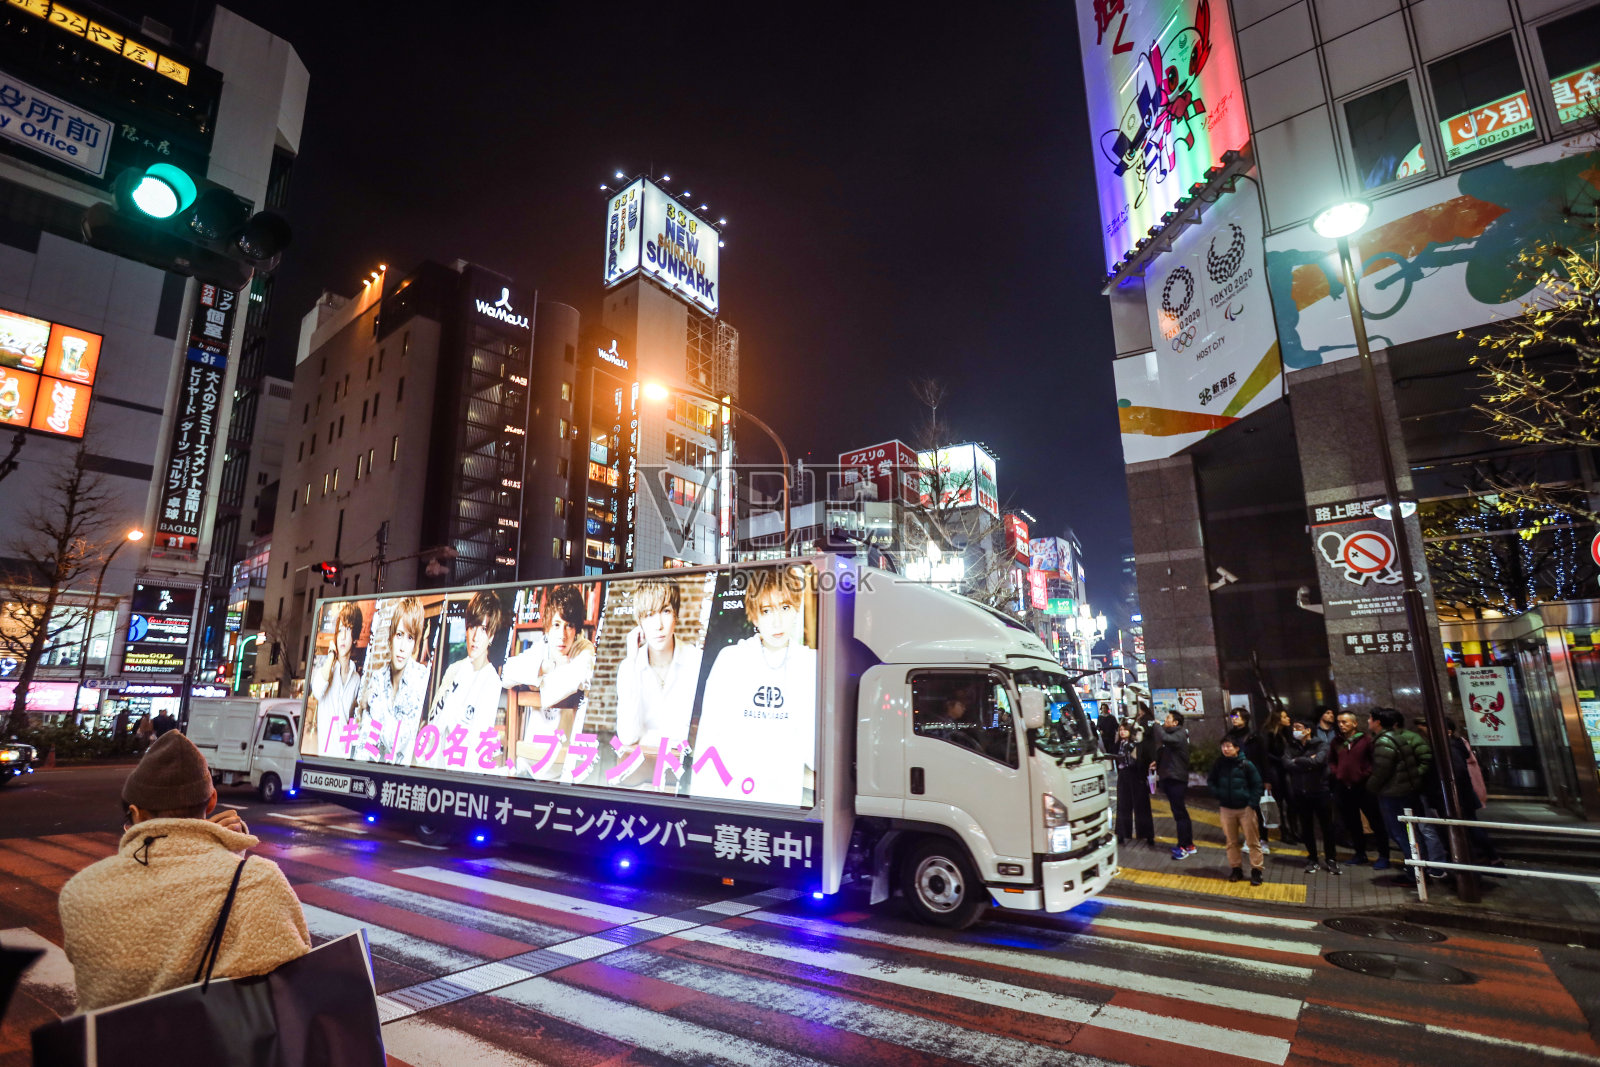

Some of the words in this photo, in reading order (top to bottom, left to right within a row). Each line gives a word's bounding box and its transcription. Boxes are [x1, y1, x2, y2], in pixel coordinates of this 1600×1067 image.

[21, 118, 79, 156] Office
[665, 216, 700, 258] NEW
[657, 232, 706, 276] SHINJUKU
[646, 240, 715, 303] SUNPARK
[1209, 285, 1235, 307] TOKYO
[1234, 268, 1253, 289] 2020
[203, 308, 226, 340] 個室
[1164, 319, 1185, 341] TOKYO
[1184, 308, 1200, 327] 2020
[200, 352, 217, 365] 3F
[1196, 345, 1212, 361] HOST
[1212, 335, 1226, 352] CITY
[1212, 371, 1237, 395] 新宿区
[850, 449, 886, 465] クスリの
[159, 522, 198, 535] BAGUS
[722, 600, 744, 609] ISSA
[1346, 632, 1412, 645] 新宿区役
[309, 774, 323, 786] LAG
[324, 775, 349, 789] GROUP
[352, 780, 365, 794] 検索
[380, 780, 489, 820] 新店舗OPEN!
[494, 796, 813, 869] オープニングメンバー募集中!
